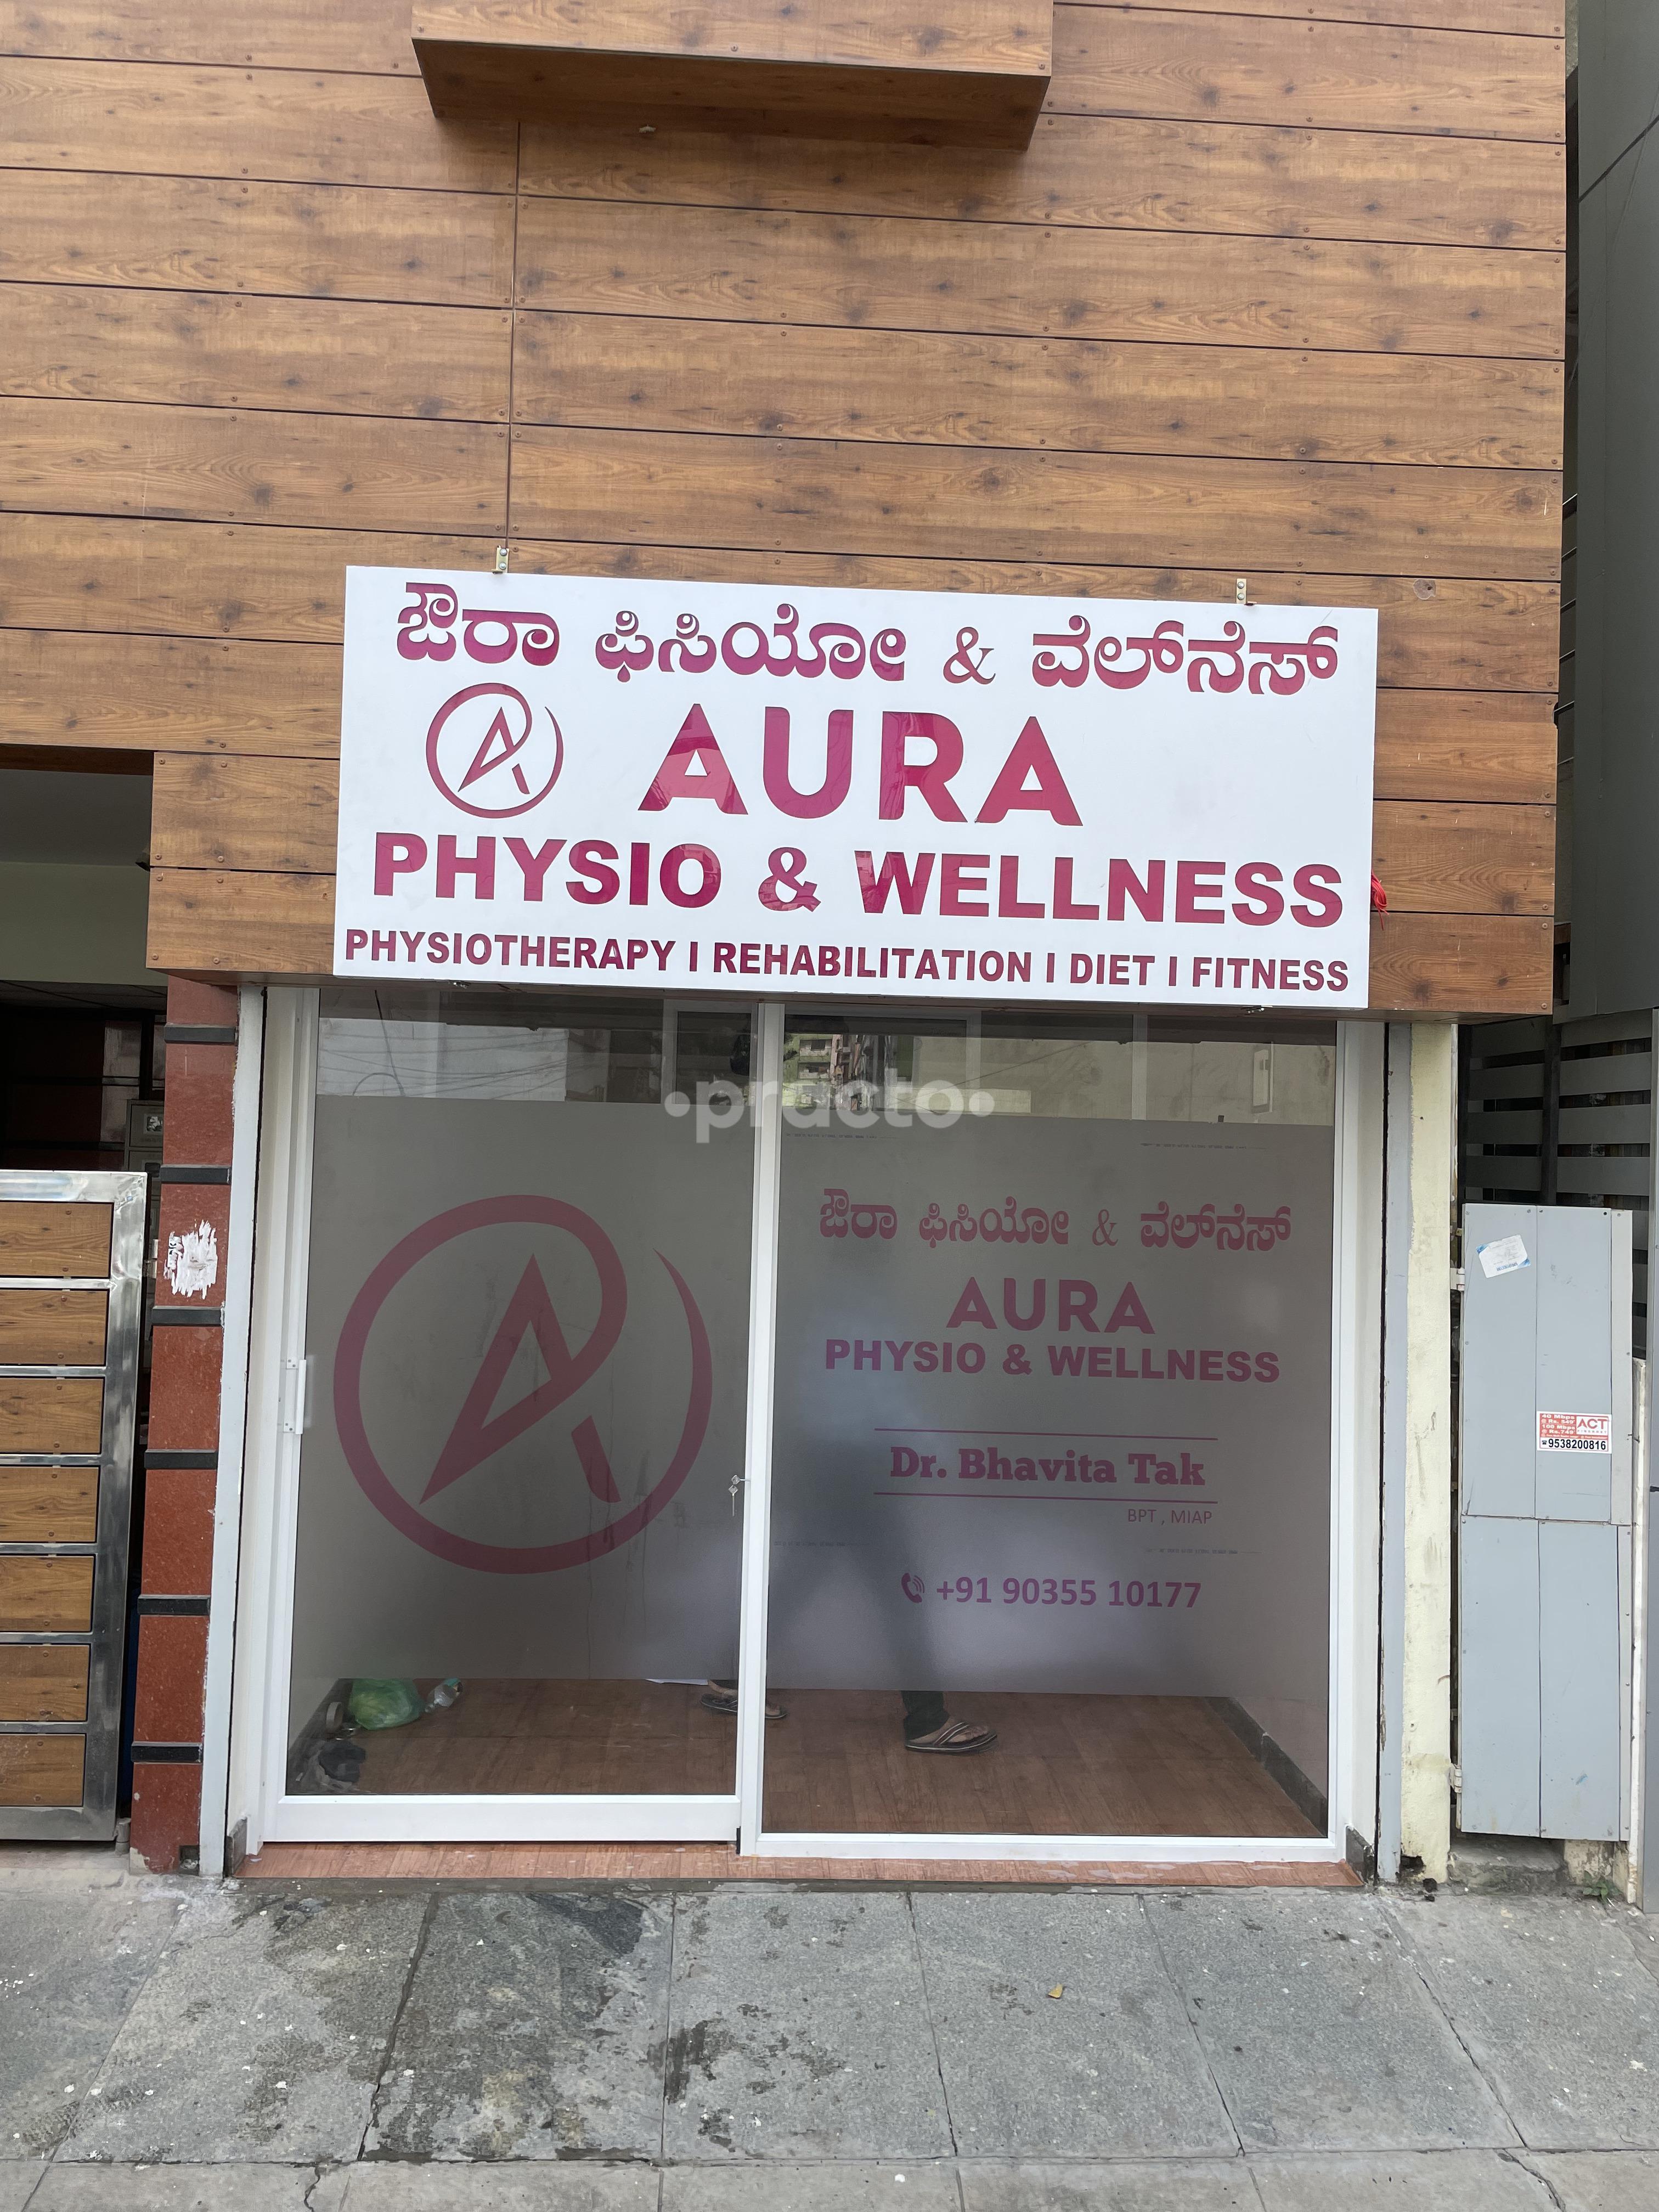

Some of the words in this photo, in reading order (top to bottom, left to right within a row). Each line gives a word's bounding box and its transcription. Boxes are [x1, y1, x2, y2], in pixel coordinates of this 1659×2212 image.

[943, 628, 996, 684] &
[638, 704, 1082, 826] AURA
[374, 833, 721, 909] PHYSIO
[758, 847, 821, 912] &
[855, 851, 1342, 928] WELLNESS
[347, 929, 675, 971] PHYSIOTHERAPY
[713, 942, 1031, 981] REHABILITATION
[1070, 953, 1154, 985] DIET
[1193, 957, 1348, 991] FITNESS
[1092, 1209, 1119, 1246] &
[946, 1277, 1155, 1335] AURA
[826, 1339, 986, 1373] PHYSIO
[1003, 1344, 1032, 1375] &
[1047, 1345, 1280, 1383] WELLNESS
[1548, 1438, 1606, 1450] 9538200816
[1577, 1418, 1607, 1429] ACT
[890, 1446, 946, 1478] Dr.
[958, 1447, 1116, 1483] Bhavita
[1128, 1452, 1205, 1486] Tak
[1128, 1509, 1156, 1522] BPT
[1171, 1510, 1212, 1524] MIAP
[936, 1576, 992, 1603] +91
[1002, 1577, 1097, 1606] 90355
[1107, 1579, 1201, 1607] 10177
